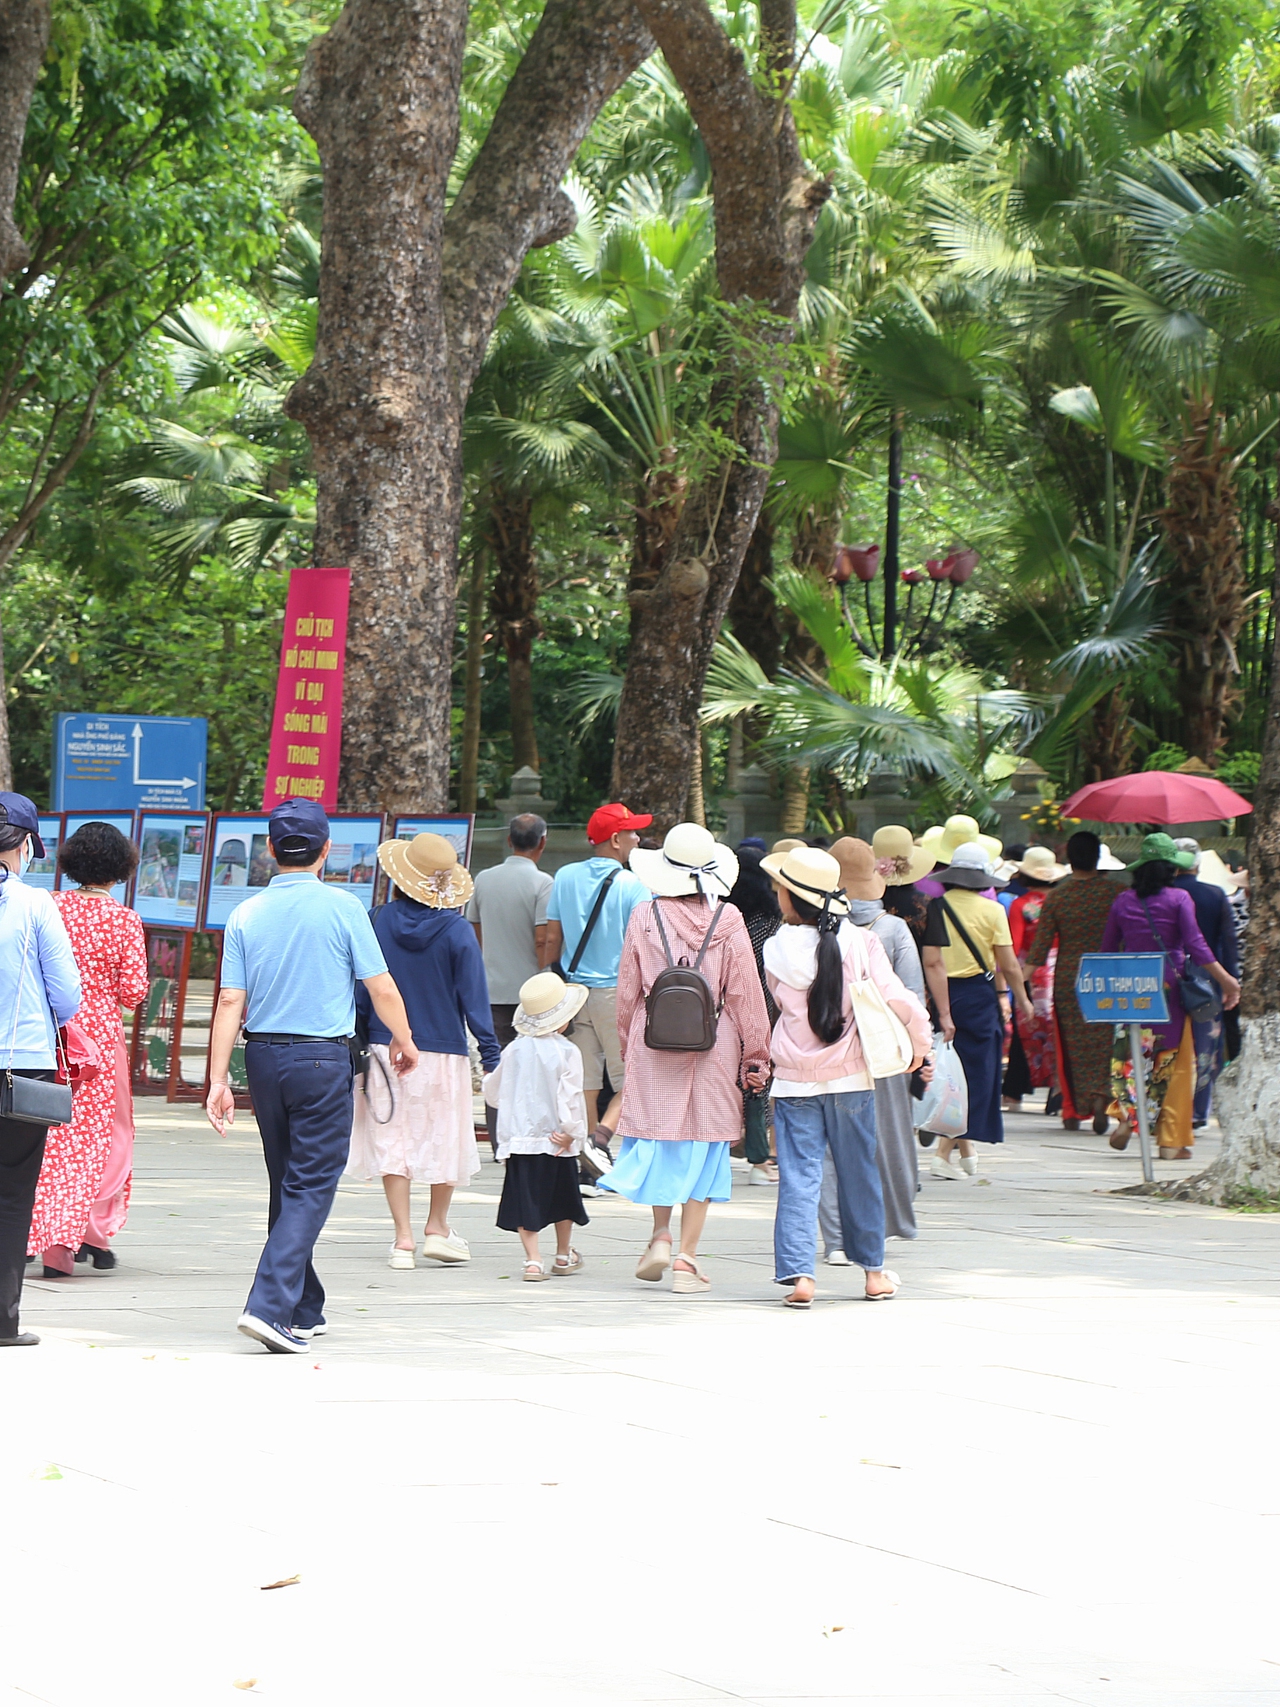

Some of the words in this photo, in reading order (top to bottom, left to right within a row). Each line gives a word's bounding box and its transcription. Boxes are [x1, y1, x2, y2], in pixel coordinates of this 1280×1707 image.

[295, 612, 314, 637] CHỦ
[315, 618, 335, 642] TỊCH
[315, 650, 339, 671] MINH
[283, 707, 310, 733] SỐNG
[287, 744, 320, 766] TRONG
[1079, 972, 1093, 993] LỐI
[1095, 976, 1106, 994] ĐI
[1108, 976, 1133, 993] THAM
[1134, 976, 1158, 994] QUAN
[1097, 997, 1114, 1009] WAY
[1117, 997, 1128, 1009] TO
[1132, 997, 1151, 1009] VISIT
